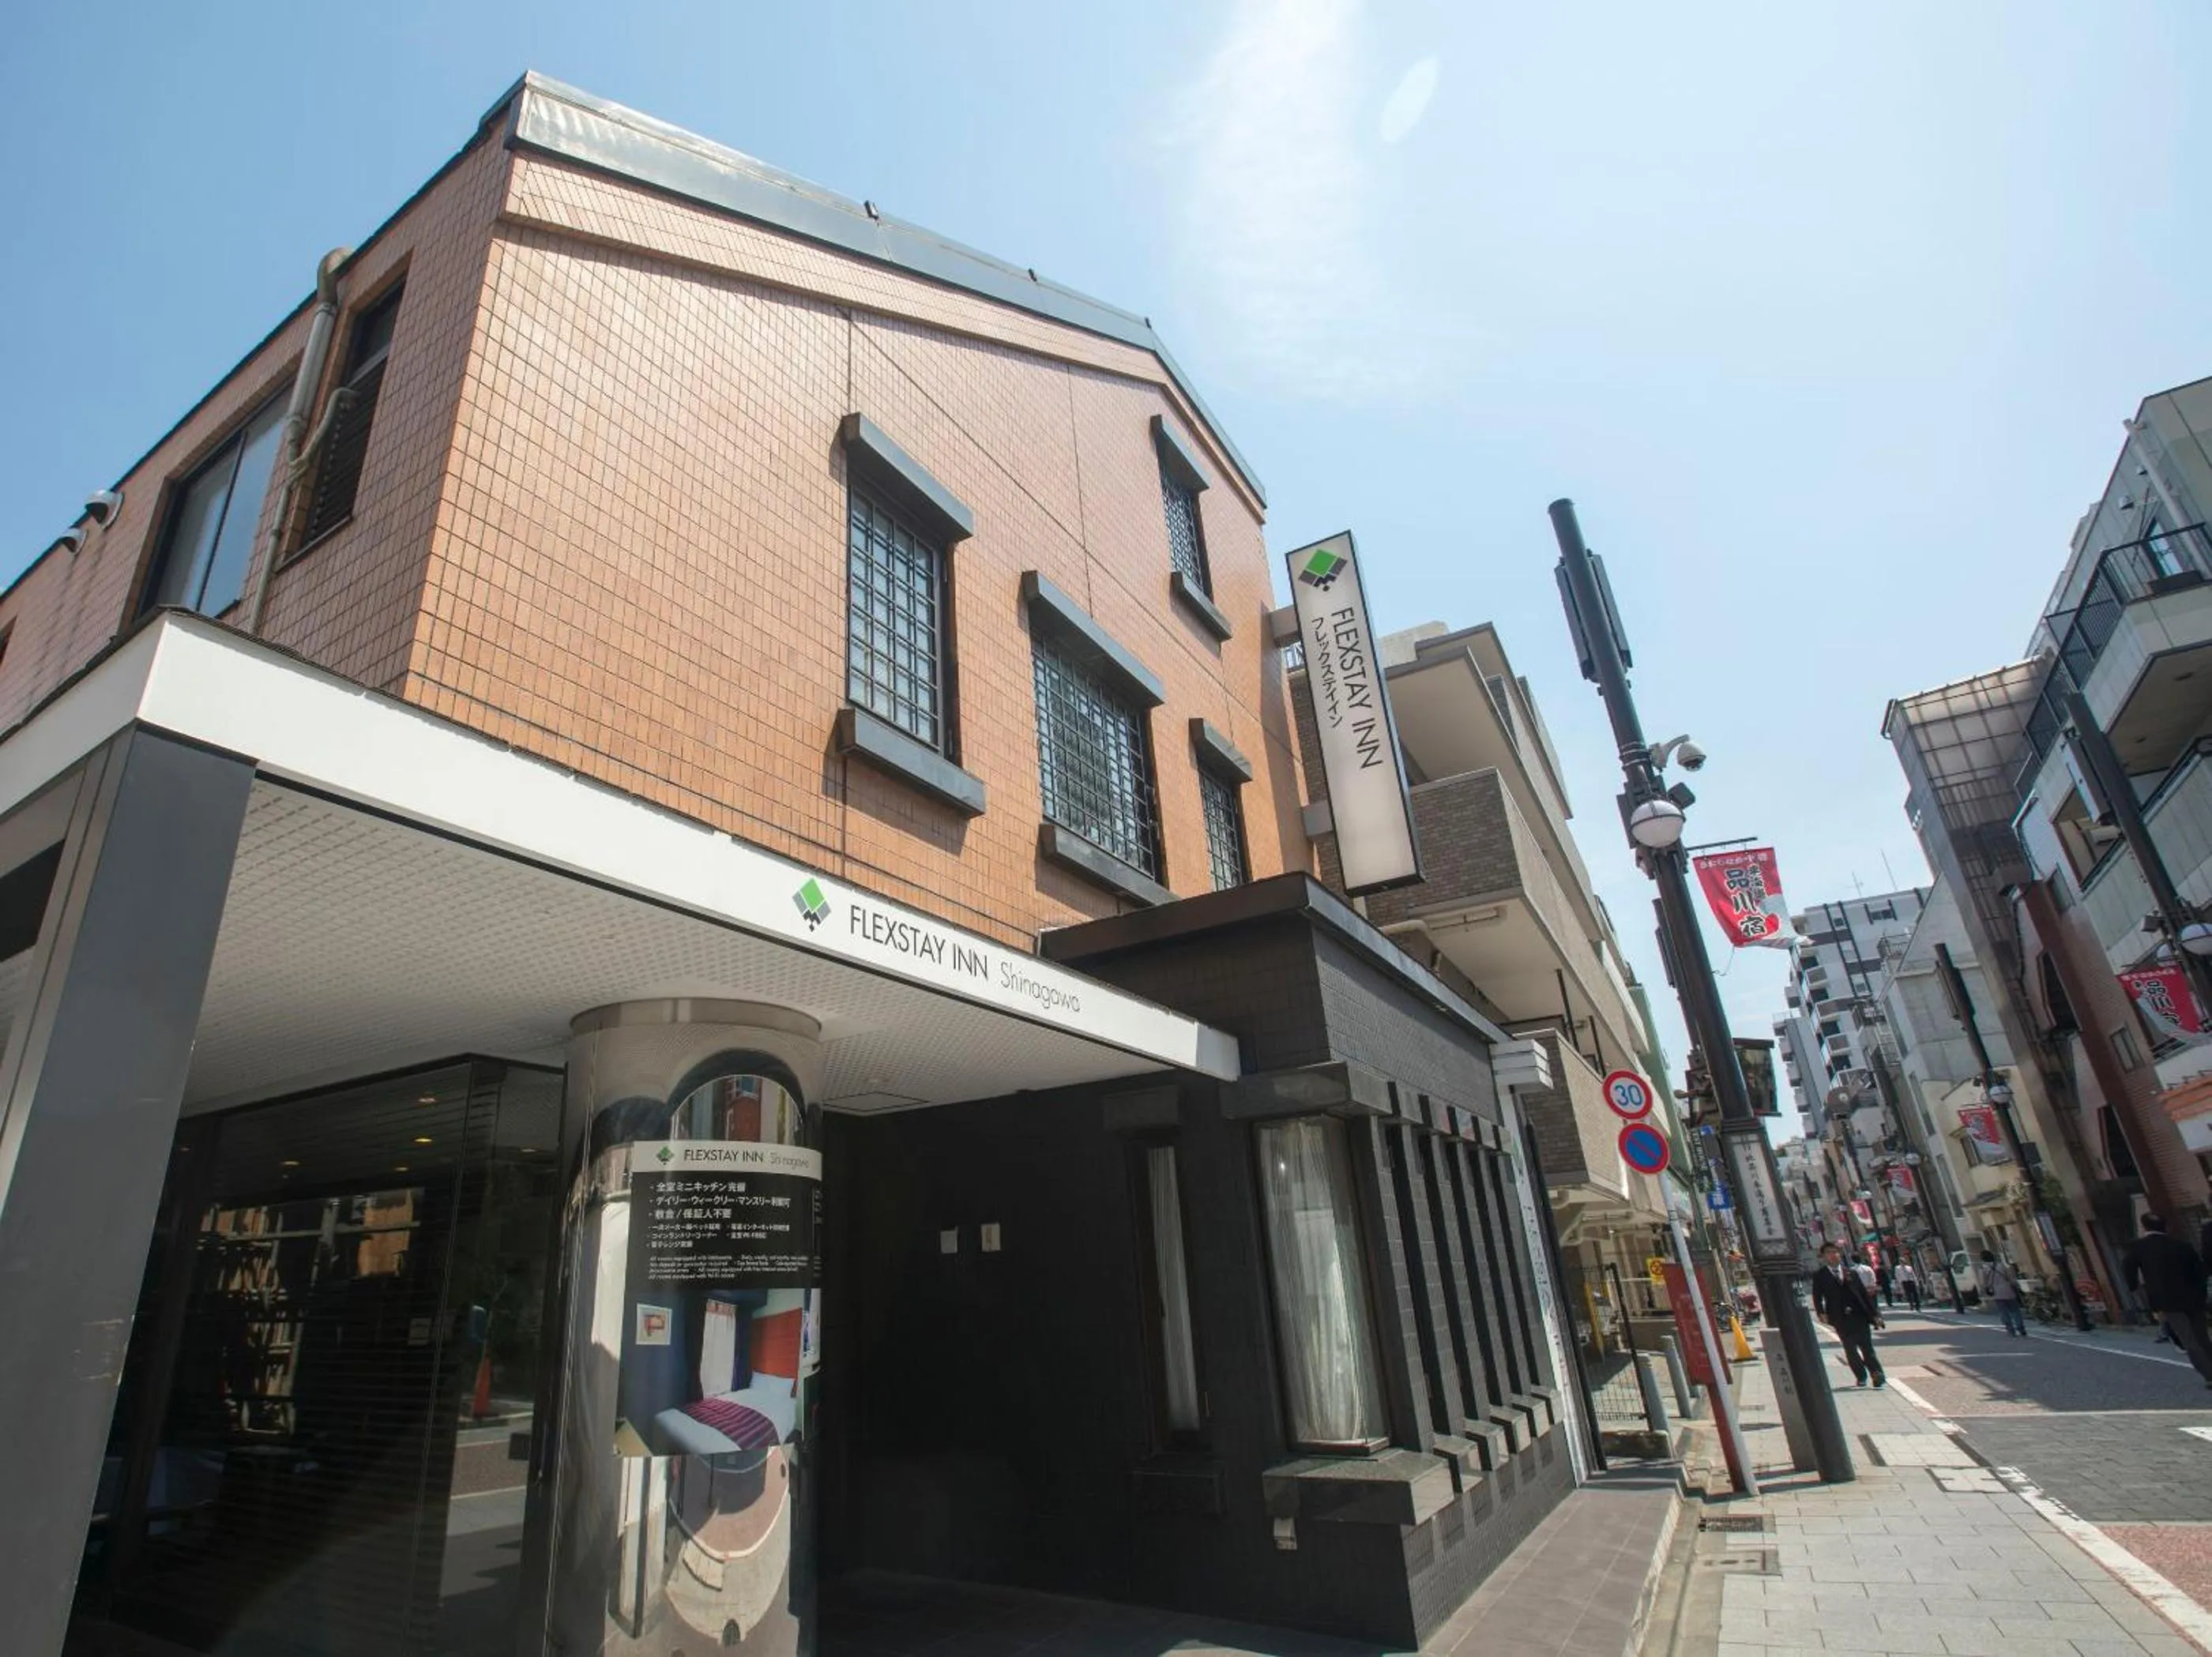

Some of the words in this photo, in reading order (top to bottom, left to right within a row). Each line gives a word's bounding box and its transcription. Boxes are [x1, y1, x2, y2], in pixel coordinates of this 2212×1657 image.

[1311, 617, 1343, 728] フレックステイイン
[1331, 607, 1372, 708] FLEXSTAY
[1352, 717, 1383, 769] INN
[1725, 868, 1766, 938] 品川宿
[850, 904, 946, 965] FLEXSTAY
[953, 943, 988, 980] INN
[1000, 961, 1081, 1012] Shinagawa
[1615, 1084, 1643, 1107] 30
[683, 1149, 739, 1162] FLEXSTAY
[743, 1151, 764, 1163] INN
